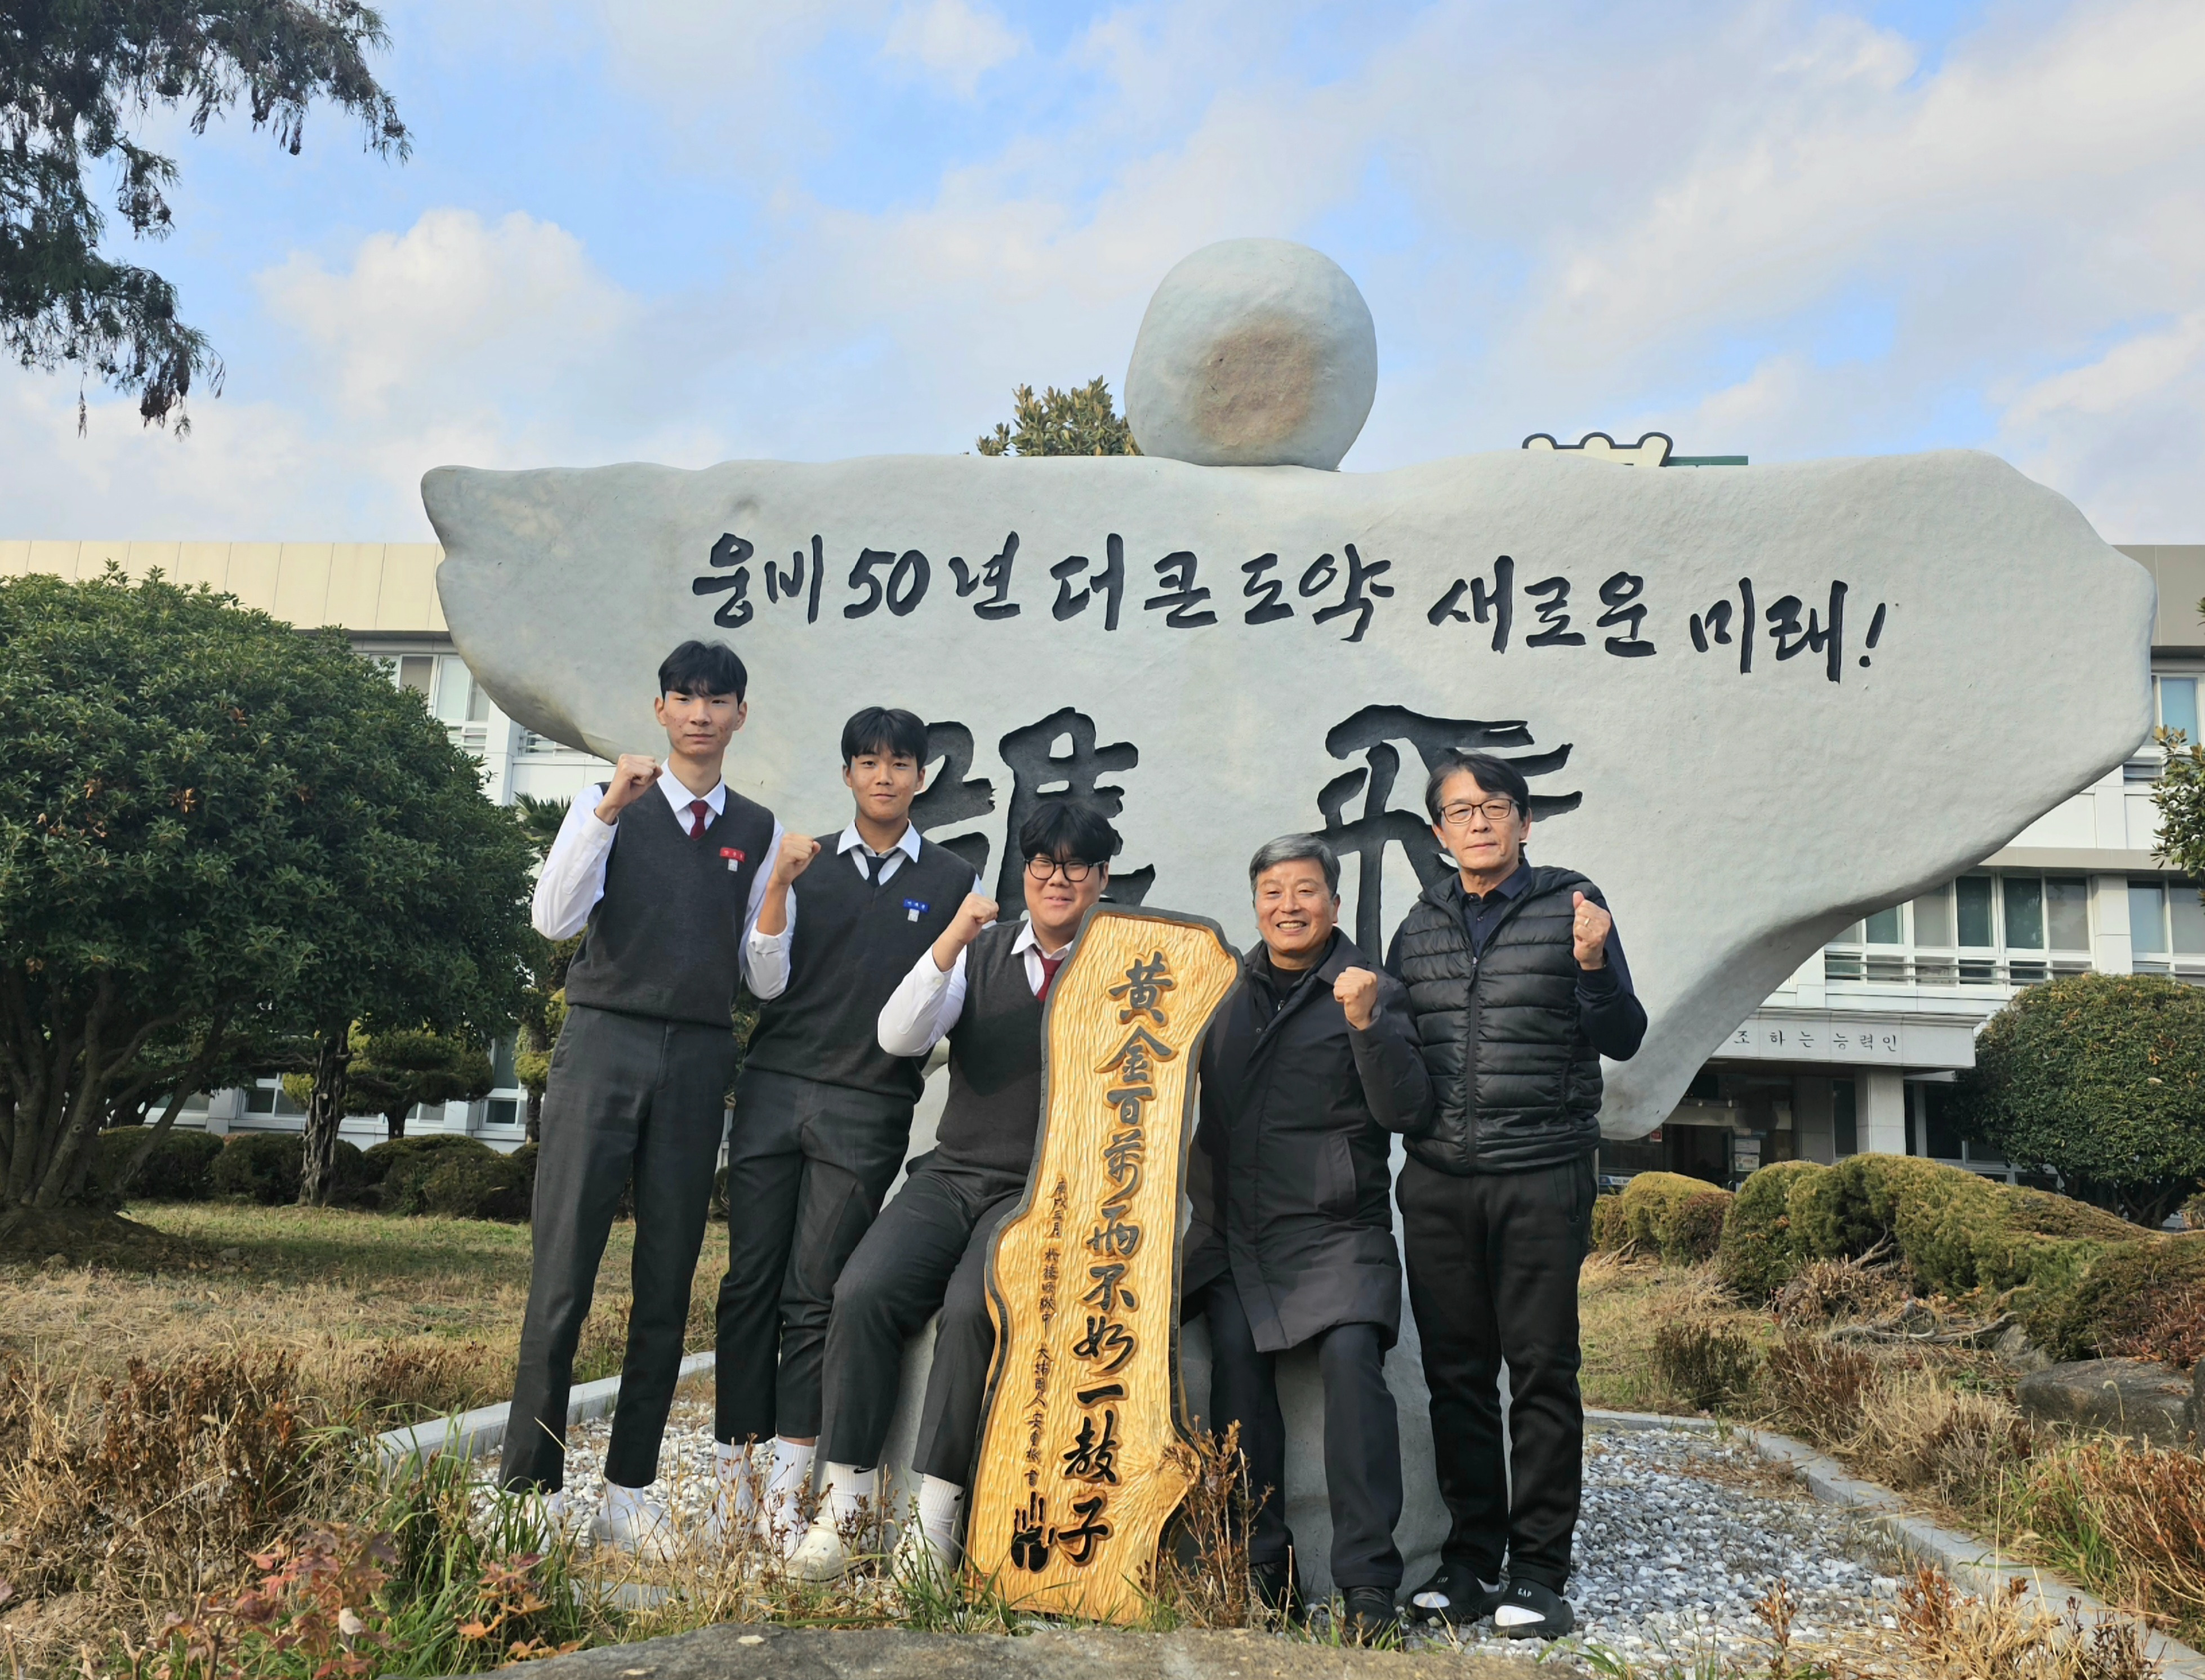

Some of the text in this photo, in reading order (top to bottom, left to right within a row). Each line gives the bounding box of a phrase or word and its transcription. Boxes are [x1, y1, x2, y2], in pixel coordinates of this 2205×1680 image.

[692, 532, 824, 629] 웅비
[1241, 543, 1395, 643] 도약
[1427, 555, 1657, 658] 새로운
[1690, 577, 1886, 684] 미래!
[1833, 1032, 1896, 1052] 능력인
